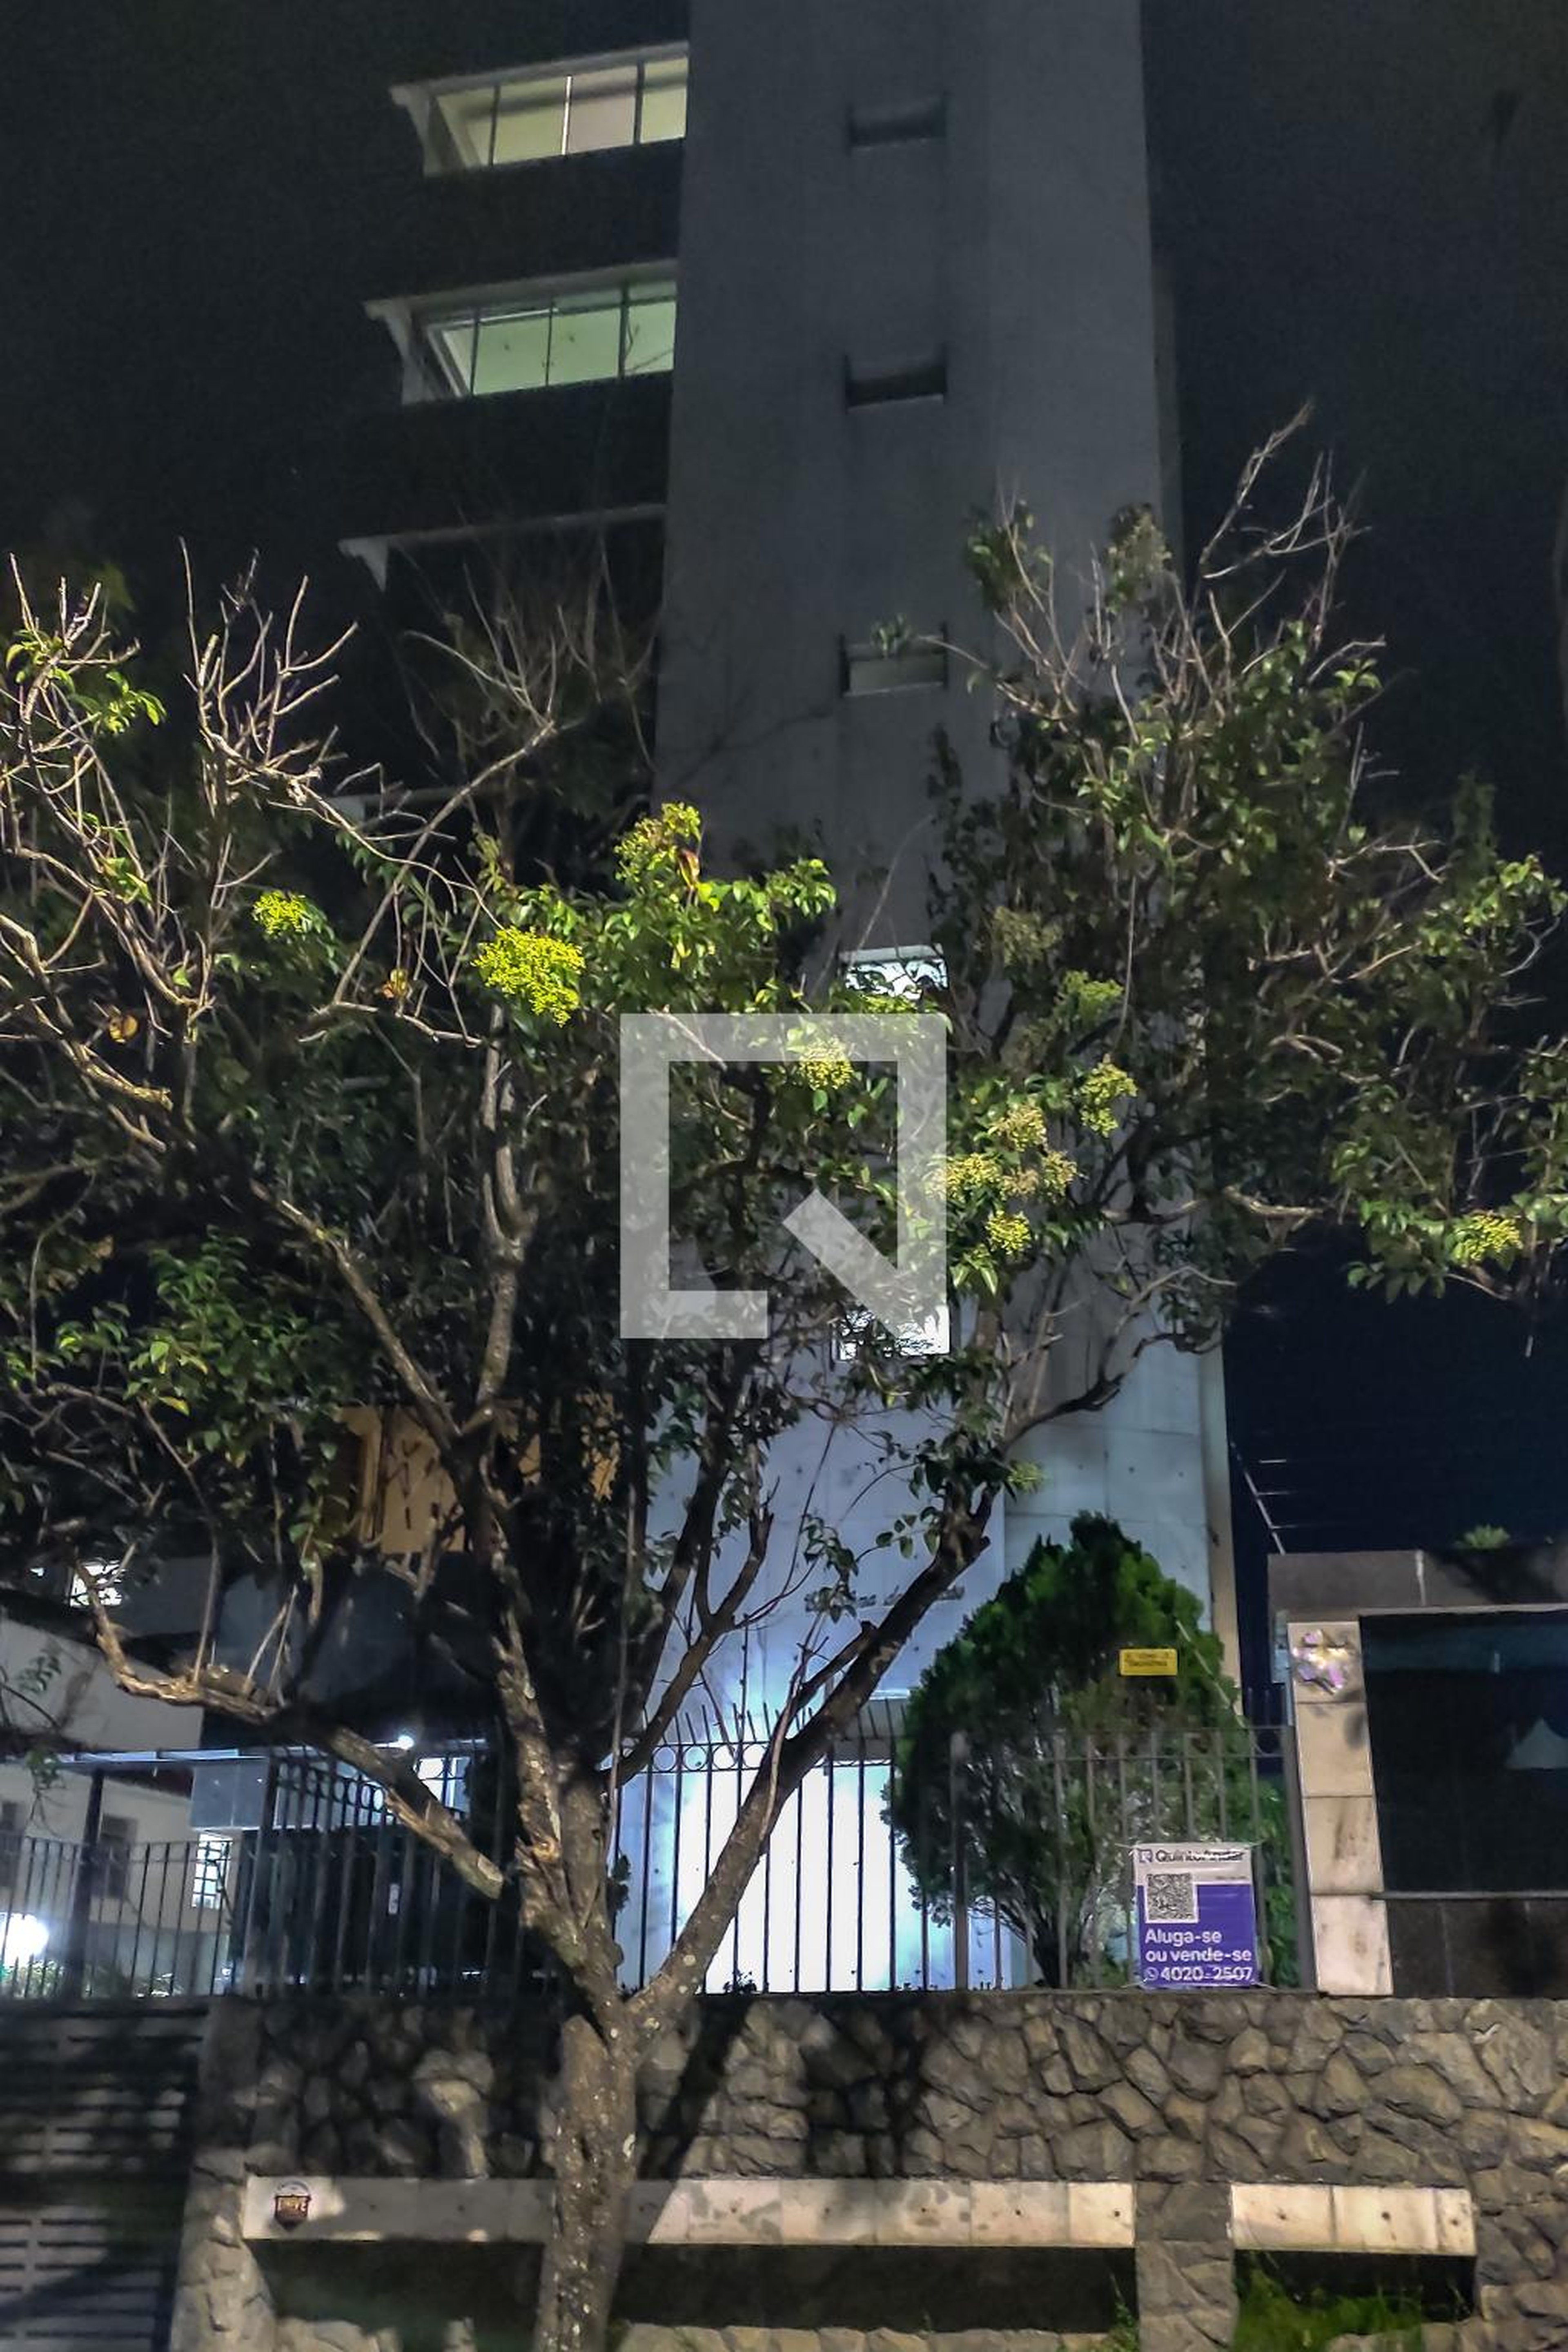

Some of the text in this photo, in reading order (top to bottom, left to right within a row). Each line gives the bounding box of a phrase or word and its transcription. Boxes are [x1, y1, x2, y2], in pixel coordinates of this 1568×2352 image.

[1145, 1929, 1222, 1947] Aluga-se
[1145, 1947, 1252, 1962] ou vende-se
